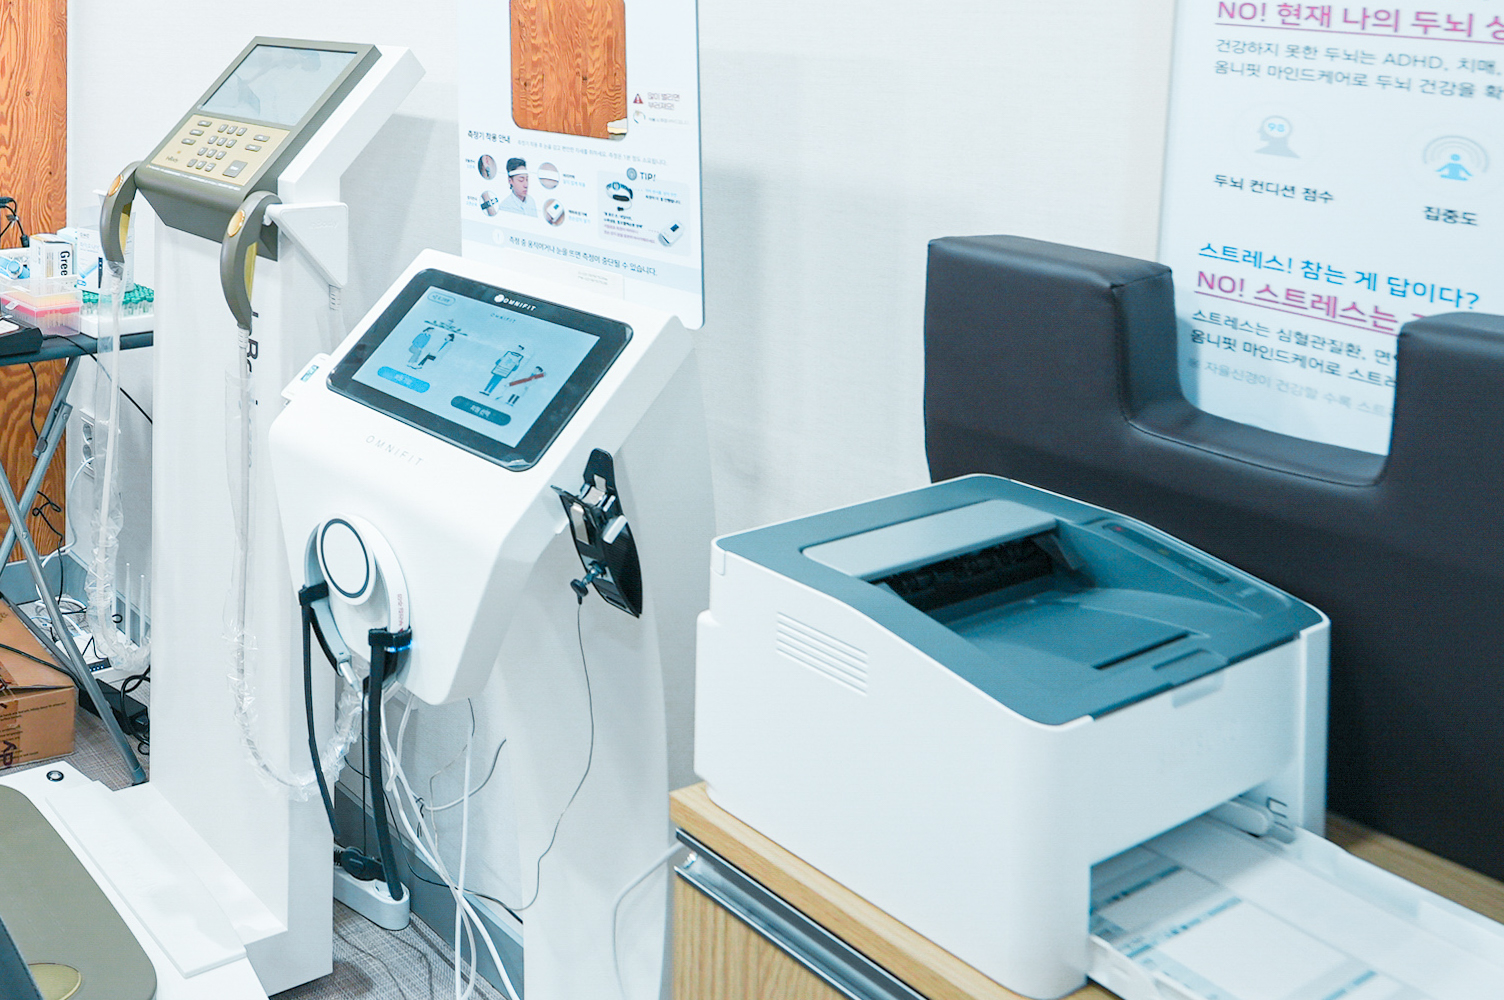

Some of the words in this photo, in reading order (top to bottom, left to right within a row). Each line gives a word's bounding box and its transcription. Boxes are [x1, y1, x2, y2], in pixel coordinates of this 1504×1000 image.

[1218, 1, 1267, 22] NO!
[1277, 3, 1332, 28] 현재
[1342, 6, 1400, 33] 나의
[1411, 10, 1474, 37] 두뇌
[1215, 39, 1280, 57] 건강하지
[1285, 44, 1318, 61] 못한
[1324, 46, 1377, 66] 두뇌는
[1214, 60, 1262, 78] 옴니핏
[1267, 64, 1370, 88] 마인드케어로
[1376, 75, 1413, 93] 두뇌
[1419, 78, 1477, 99] 건강을
[640, 172, 657, 182] TIP!
[1213, 174, 1245, 191] 두뇌
[1249, 179, 1296, 199] 컨디션
[1302, 187, 1335, 205] 점수
[1422, 205, 1479, 227] 집중도
[1198, 242, 1293, 275] 스트레스!
[1299, 258, 1347, 287] 참는
[1354, 271, 1378, 293] 게
[1386, 276, 1480, 311] 답이다?
[503, 298, 537, 312] OMNIFIT
[1197, 270, 1245, 298] NO!
[1254, 283, 1399, 332] 스트레스는
[1191, 309, 1271, 338] 스트레스는
[1190, 329, 1238, 353] 옴니핏
[1242, 341, 1341, 377] 마인드케어로
[365, 435, 424, 465] OMNIFIT
